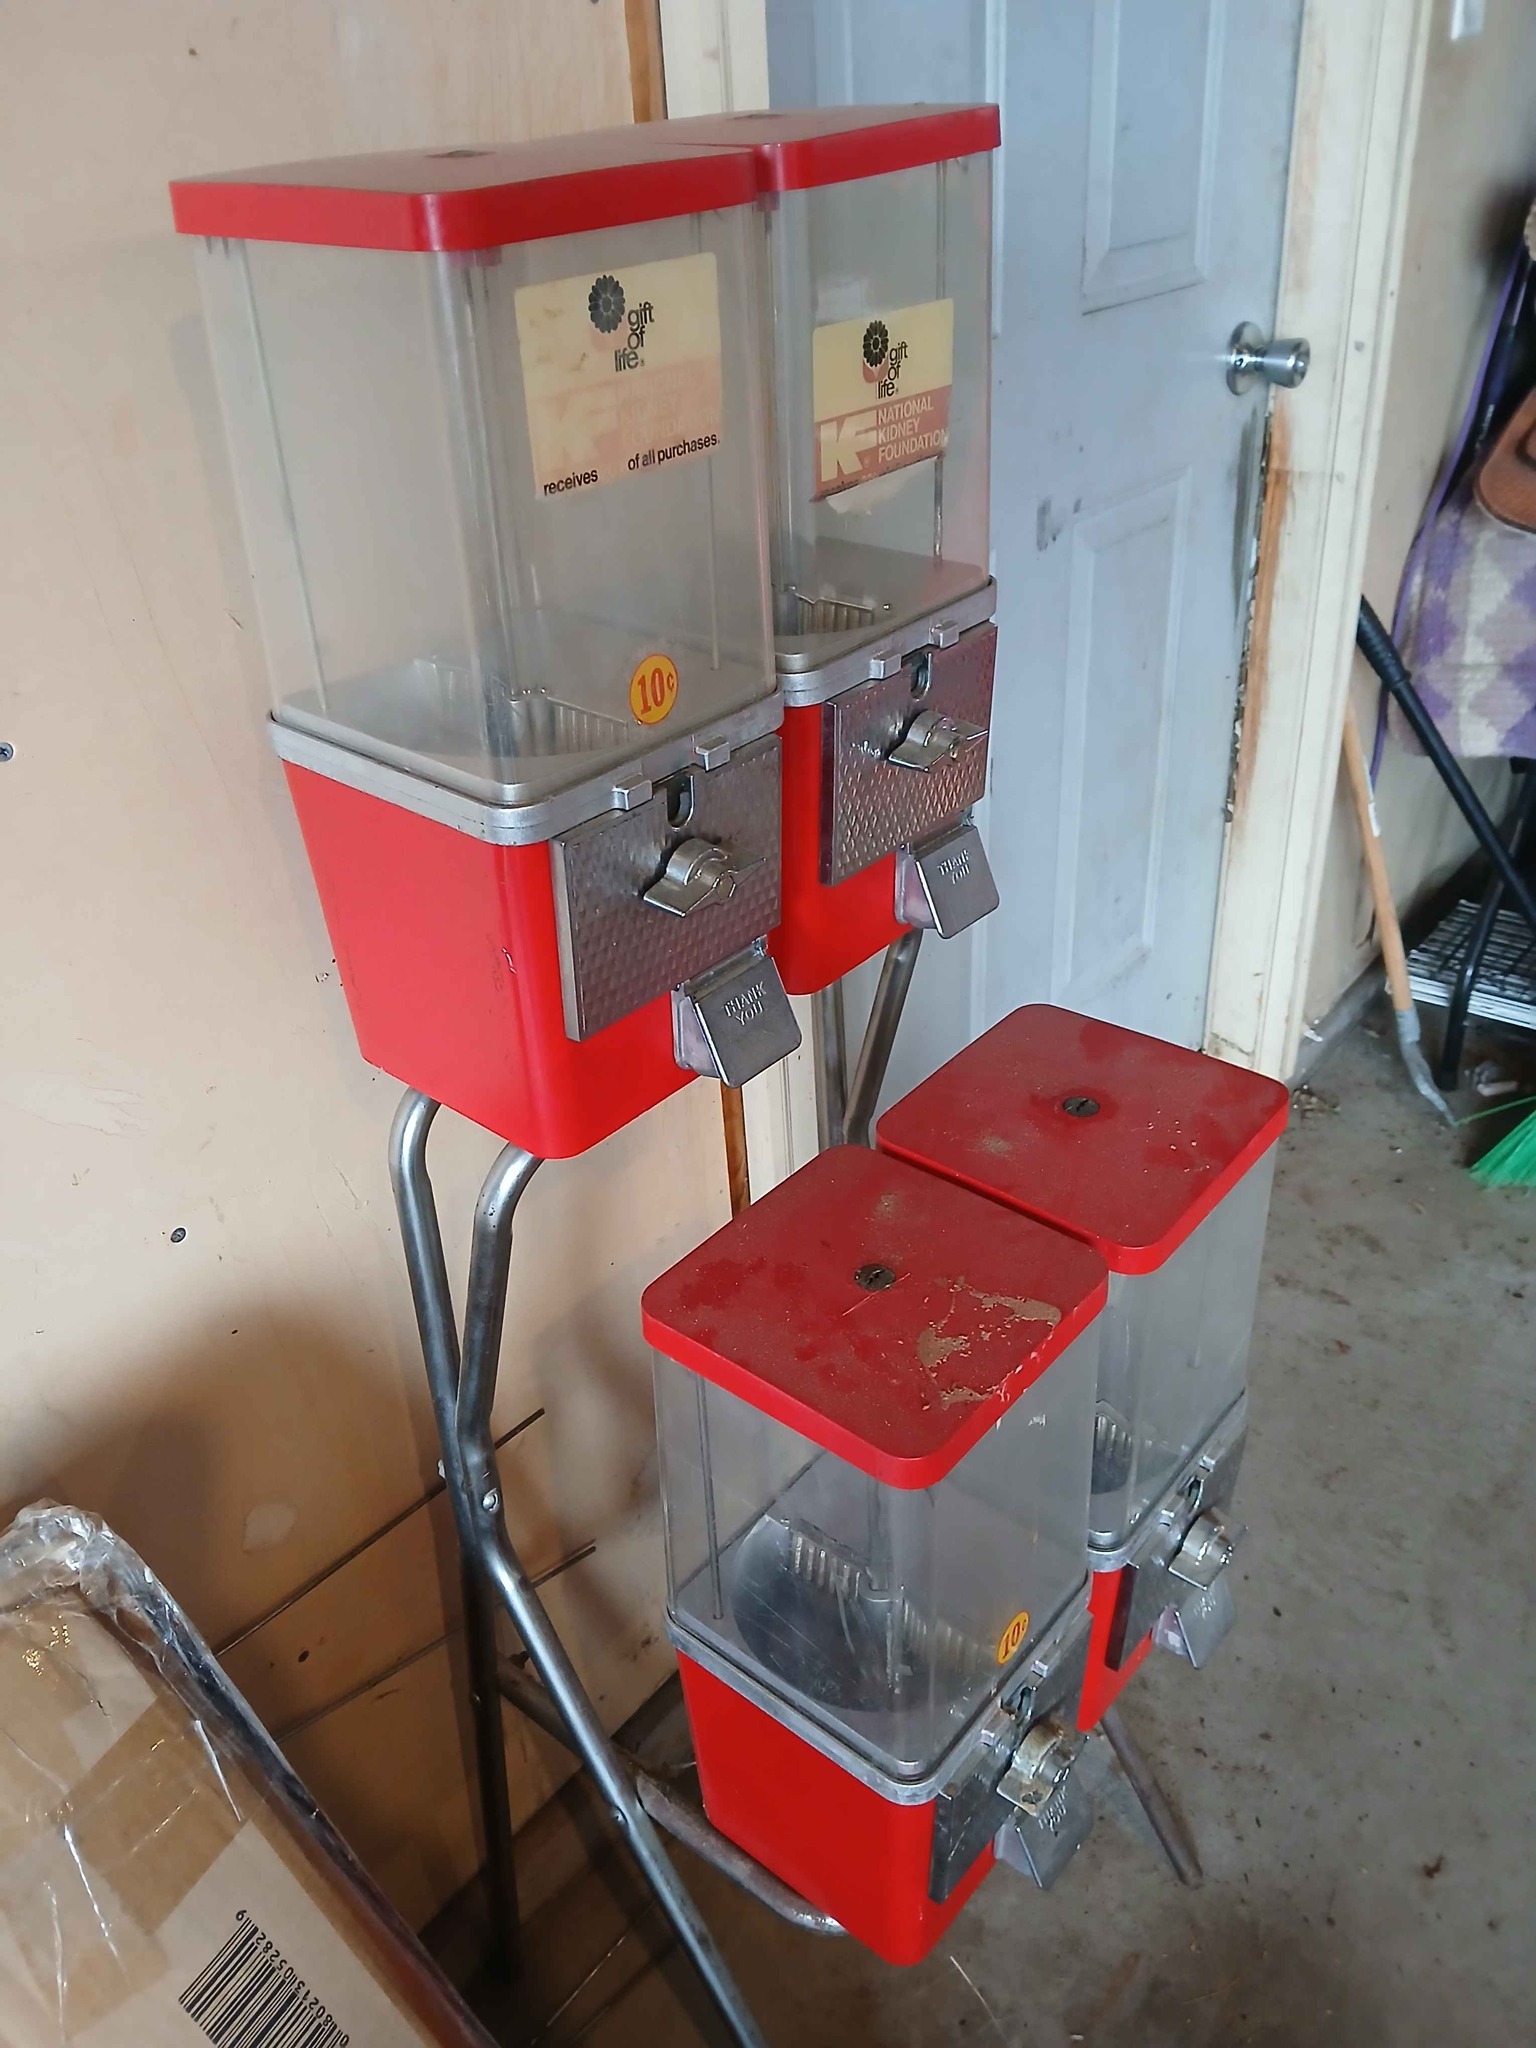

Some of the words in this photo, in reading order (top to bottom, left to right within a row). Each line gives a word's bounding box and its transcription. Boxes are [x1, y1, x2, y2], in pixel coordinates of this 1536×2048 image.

[627, 301, 655, 332] gift
[627, 325, 646, 350] of
[889, 341, 908, 366] gift
[887, 361, 901, 381] of
[877, 395, 934, 425] NATIONAL
[878, 418, 920, 444] KIDNEY
[878, 427, 949, 464] FOUNDATION
[543, 468, 599, 496] receives
[627, 453, 640, 471] of
[641, 449, 656, 467] all
[657, 433, 721, 465] purchases.
[724, 981, 767, 1017] THANK
[735, 1001, 764, 1026] YOU
